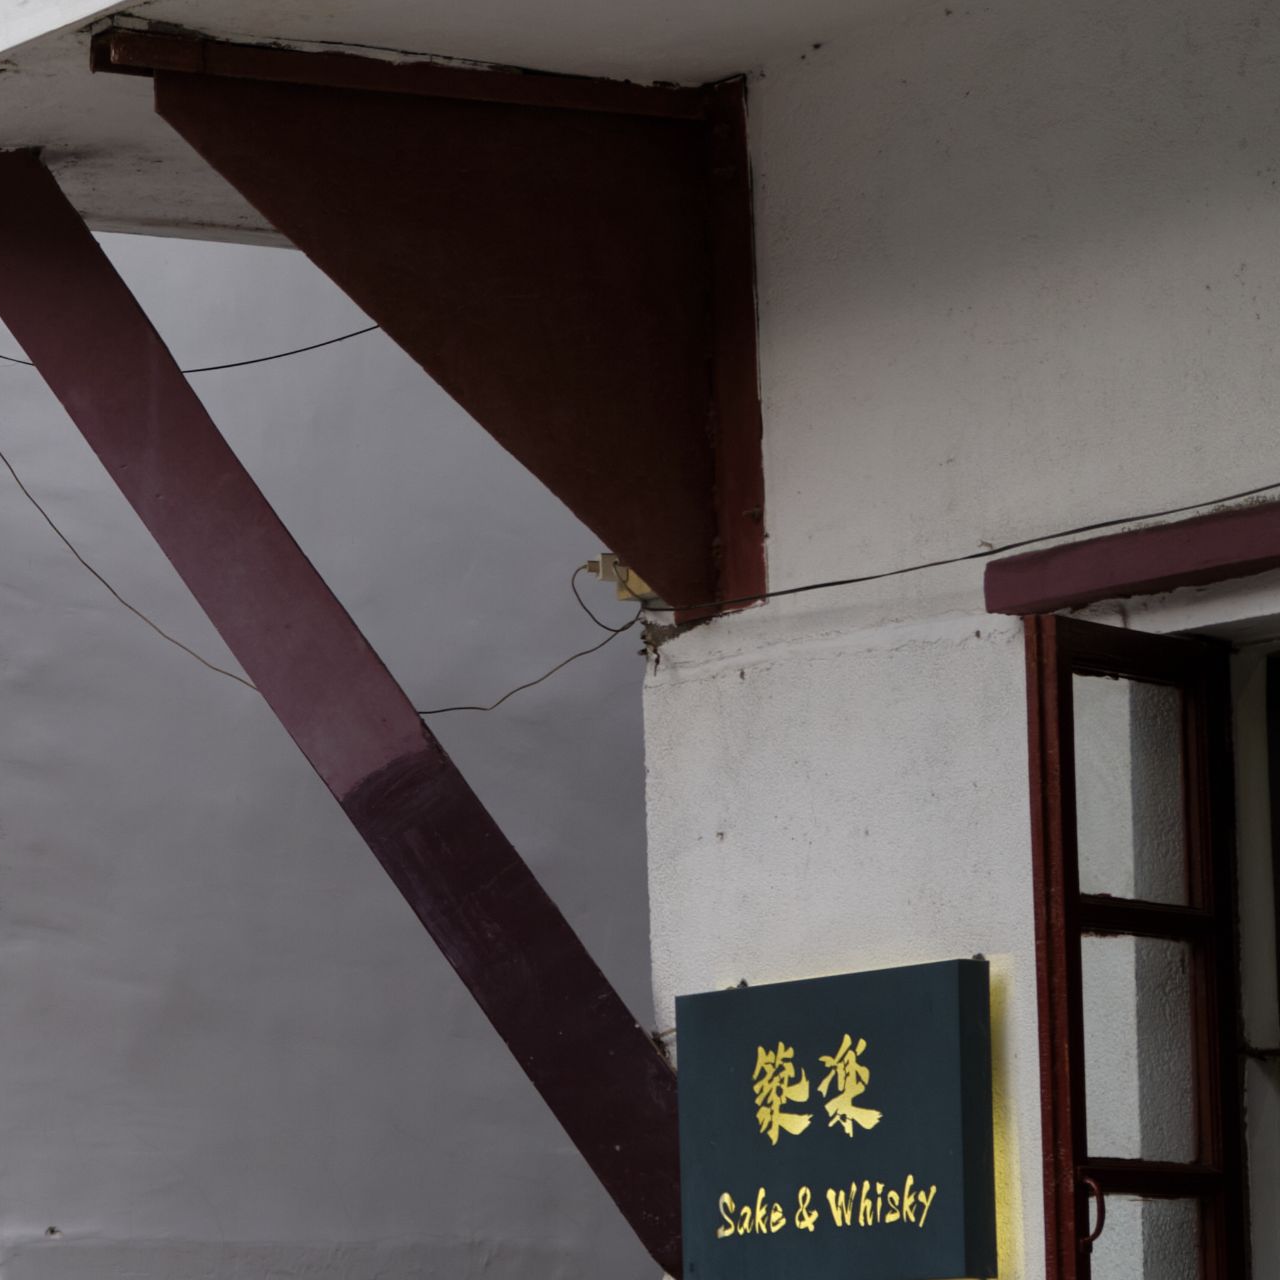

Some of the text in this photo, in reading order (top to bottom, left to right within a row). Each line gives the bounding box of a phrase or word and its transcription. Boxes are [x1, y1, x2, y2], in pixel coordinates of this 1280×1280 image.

[717, 1173, 937, 1239] Sake & Whisky
